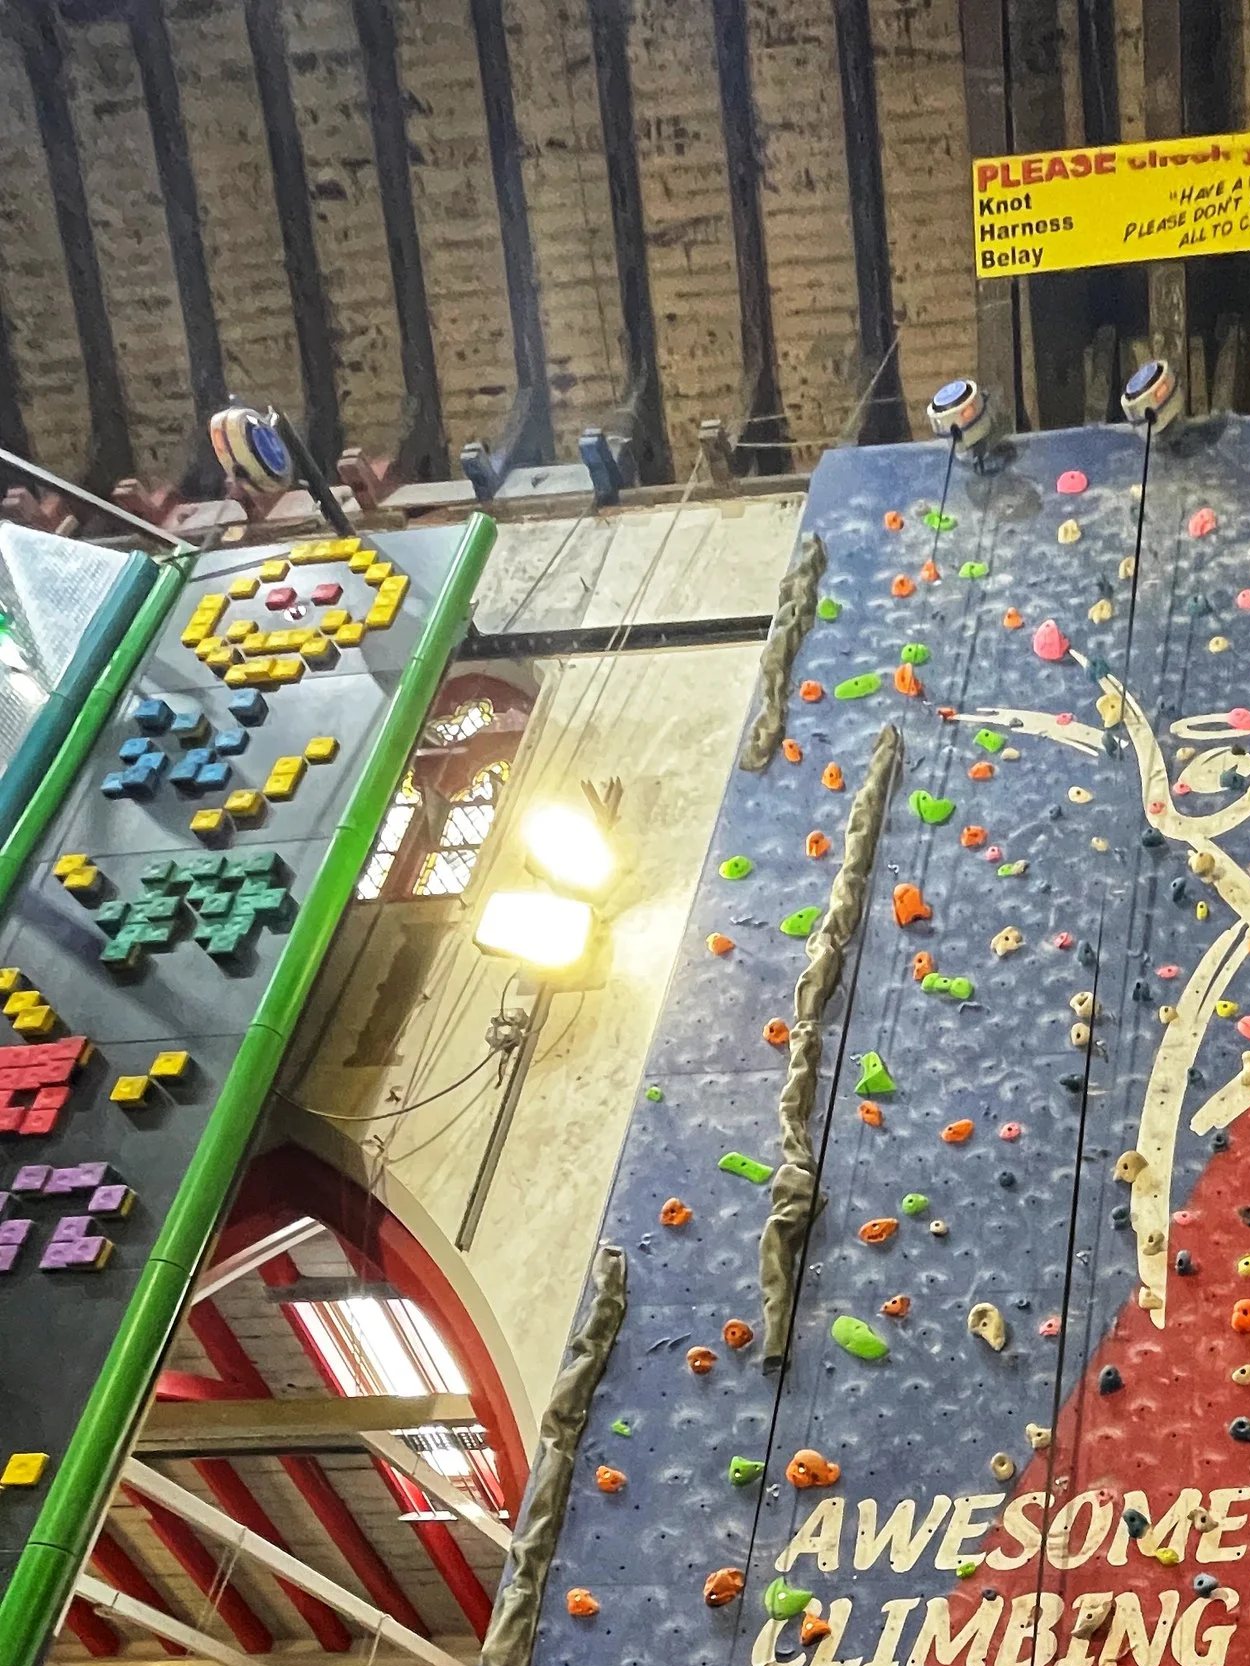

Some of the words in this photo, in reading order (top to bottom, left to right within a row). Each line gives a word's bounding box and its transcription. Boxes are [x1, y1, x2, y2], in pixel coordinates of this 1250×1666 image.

[977, 152, 1116, 193] PLEASE
[1232, 176, 1243, 192] A
[979, 192, 1032, 217] Knot
[980, 216, 1074, 242] Harness
[1123, 211, 1187, 243] PLEASE
[1193, 196, 1243, 223] DON'T
[1178, 228, 1208, 248] ALL
[1211, 219, 1234, 239] TO
[981, 246, 1044, 269] Belay
